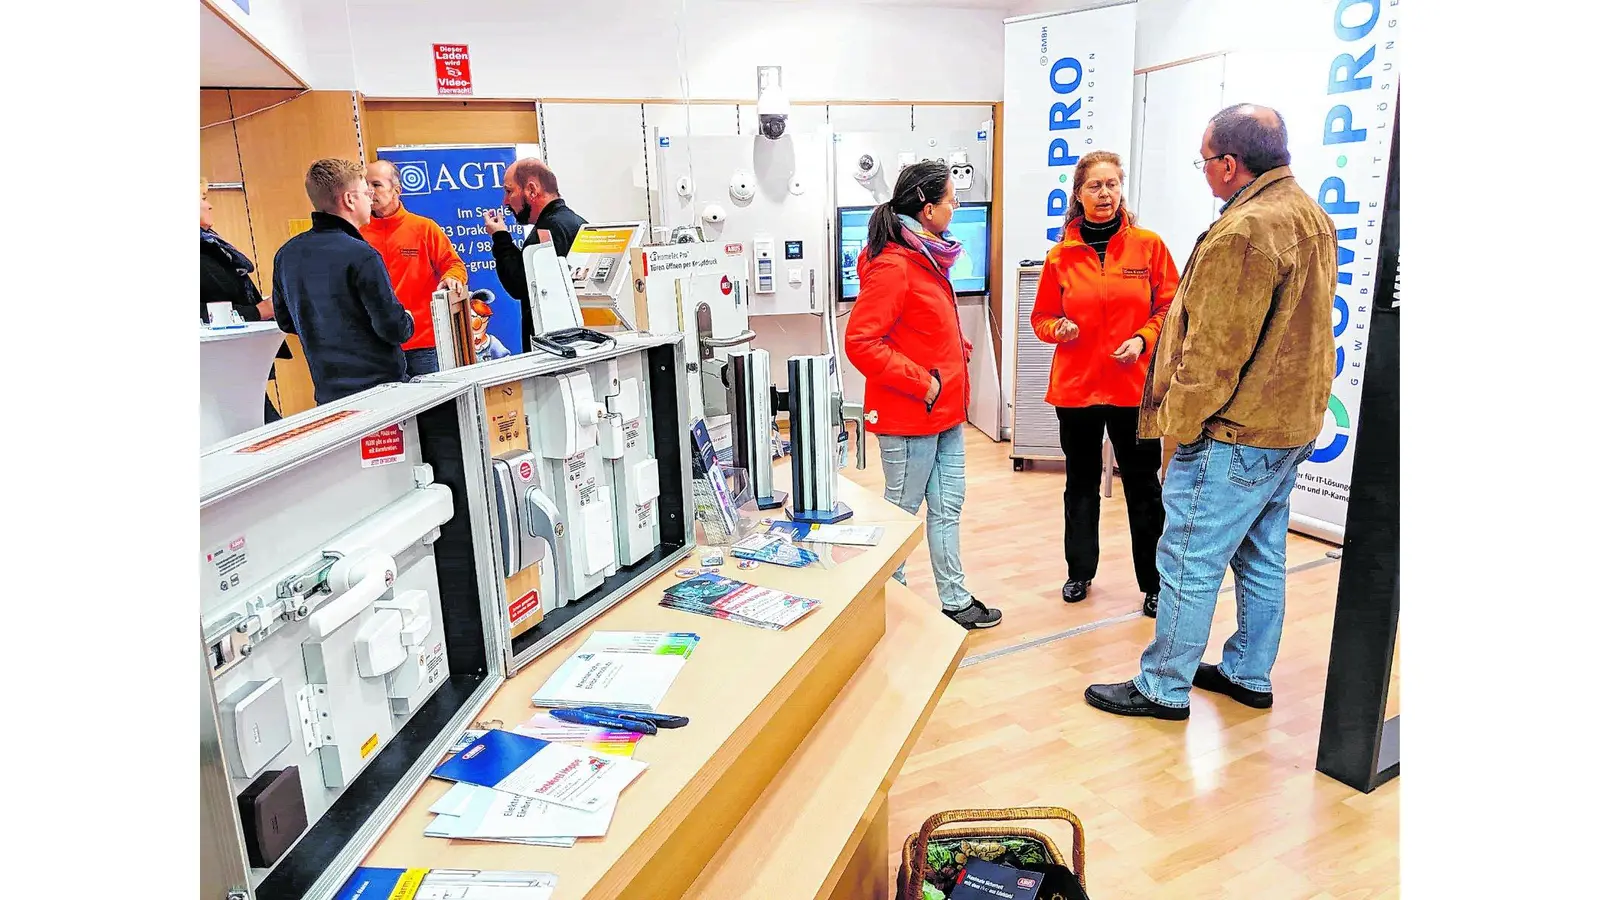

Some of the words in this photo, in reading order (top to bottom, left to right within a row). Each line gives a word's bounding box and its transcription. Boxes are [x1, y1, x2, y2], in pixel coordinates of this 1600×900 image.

[436, 51, 468, 59] Laden
[439, 78, 471, 86] Video-
[433, 162, 506, 191] AGT
[457, 207, 473, 218] Im
[1305, 472, 1315, 482] für
[1307, 486, 1320, 495] und
